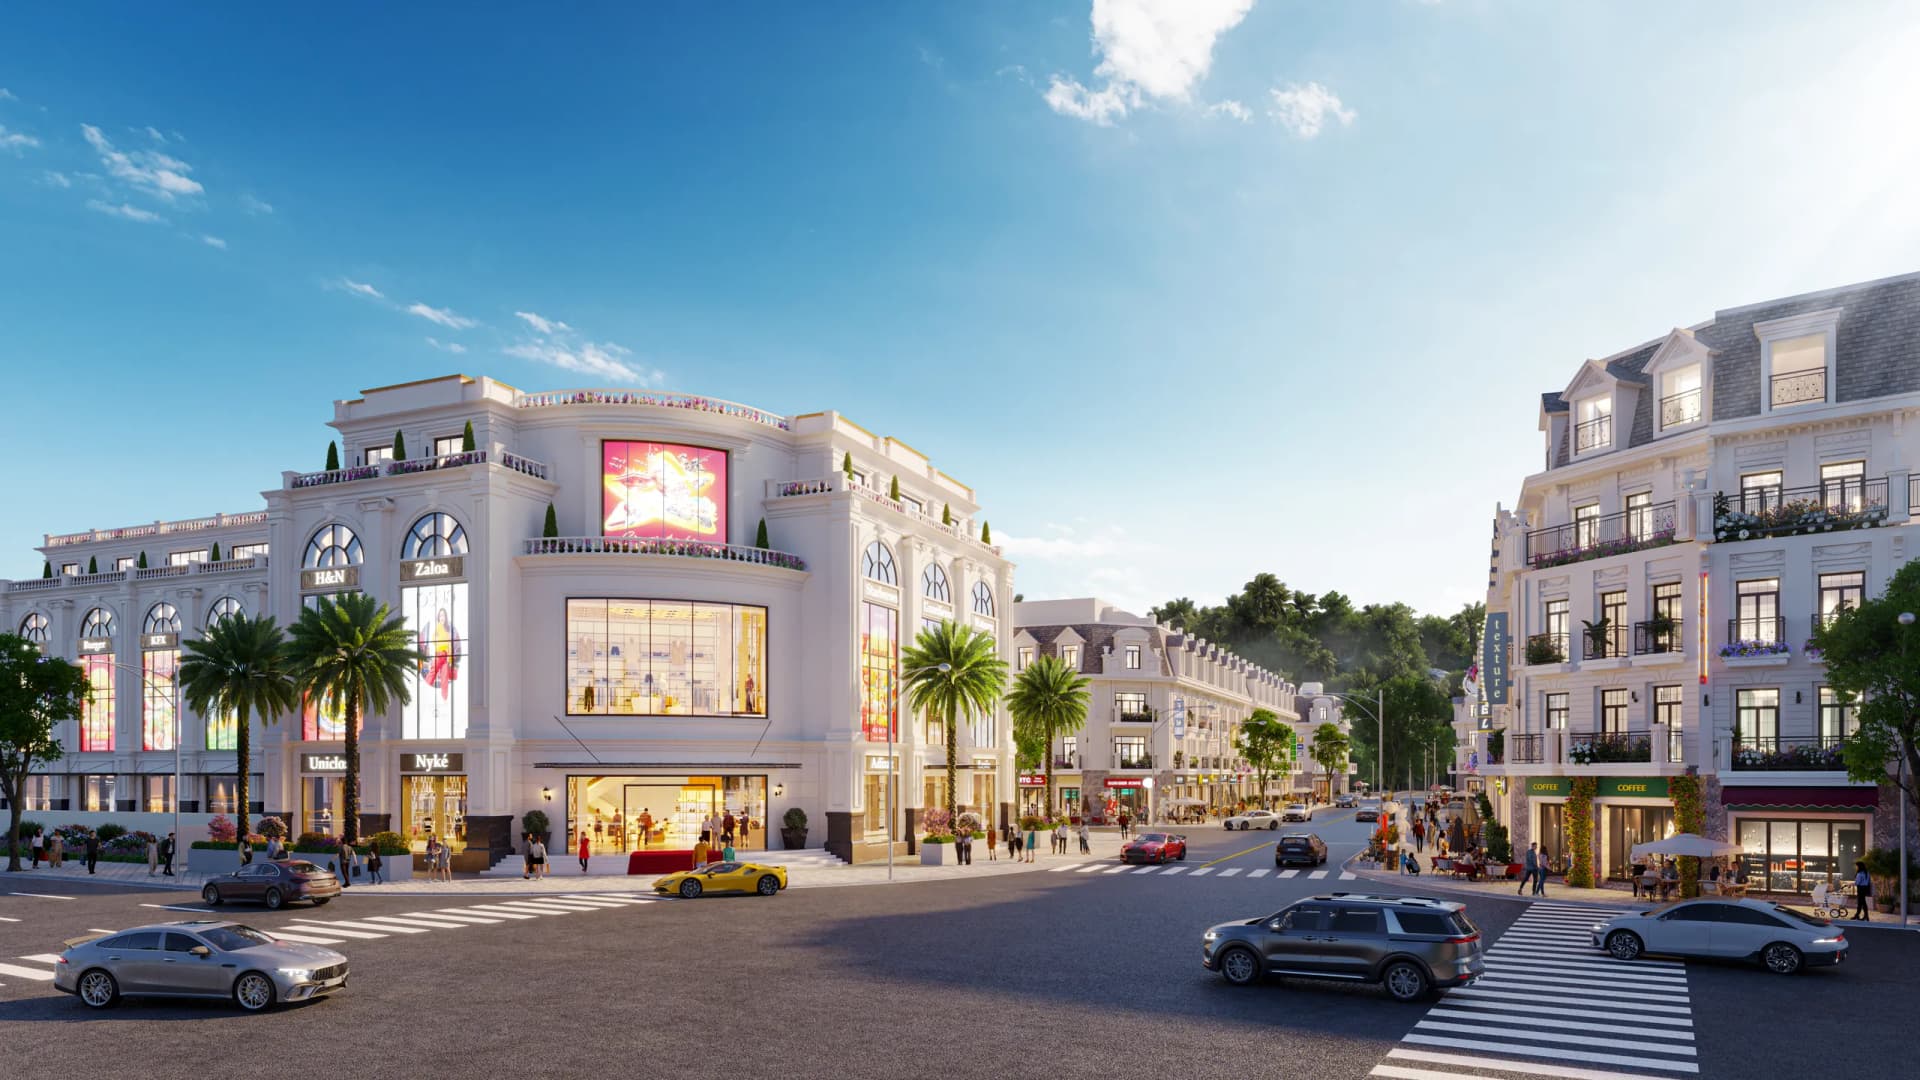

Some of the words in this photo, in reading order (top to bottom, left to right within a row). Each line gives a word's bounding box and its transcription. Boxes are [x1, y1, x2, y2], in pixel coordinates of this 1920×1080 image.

[415, 561, 449, 576] Zaloa
[314, 570, 345, 585] H&N
[1493, 619, 1501, 698] texture
[415, 753, 449, 772] Nyké
[1532, 783, 1558, 791] COFFEE
[1617, 784, 1647, 792] COFFEE
